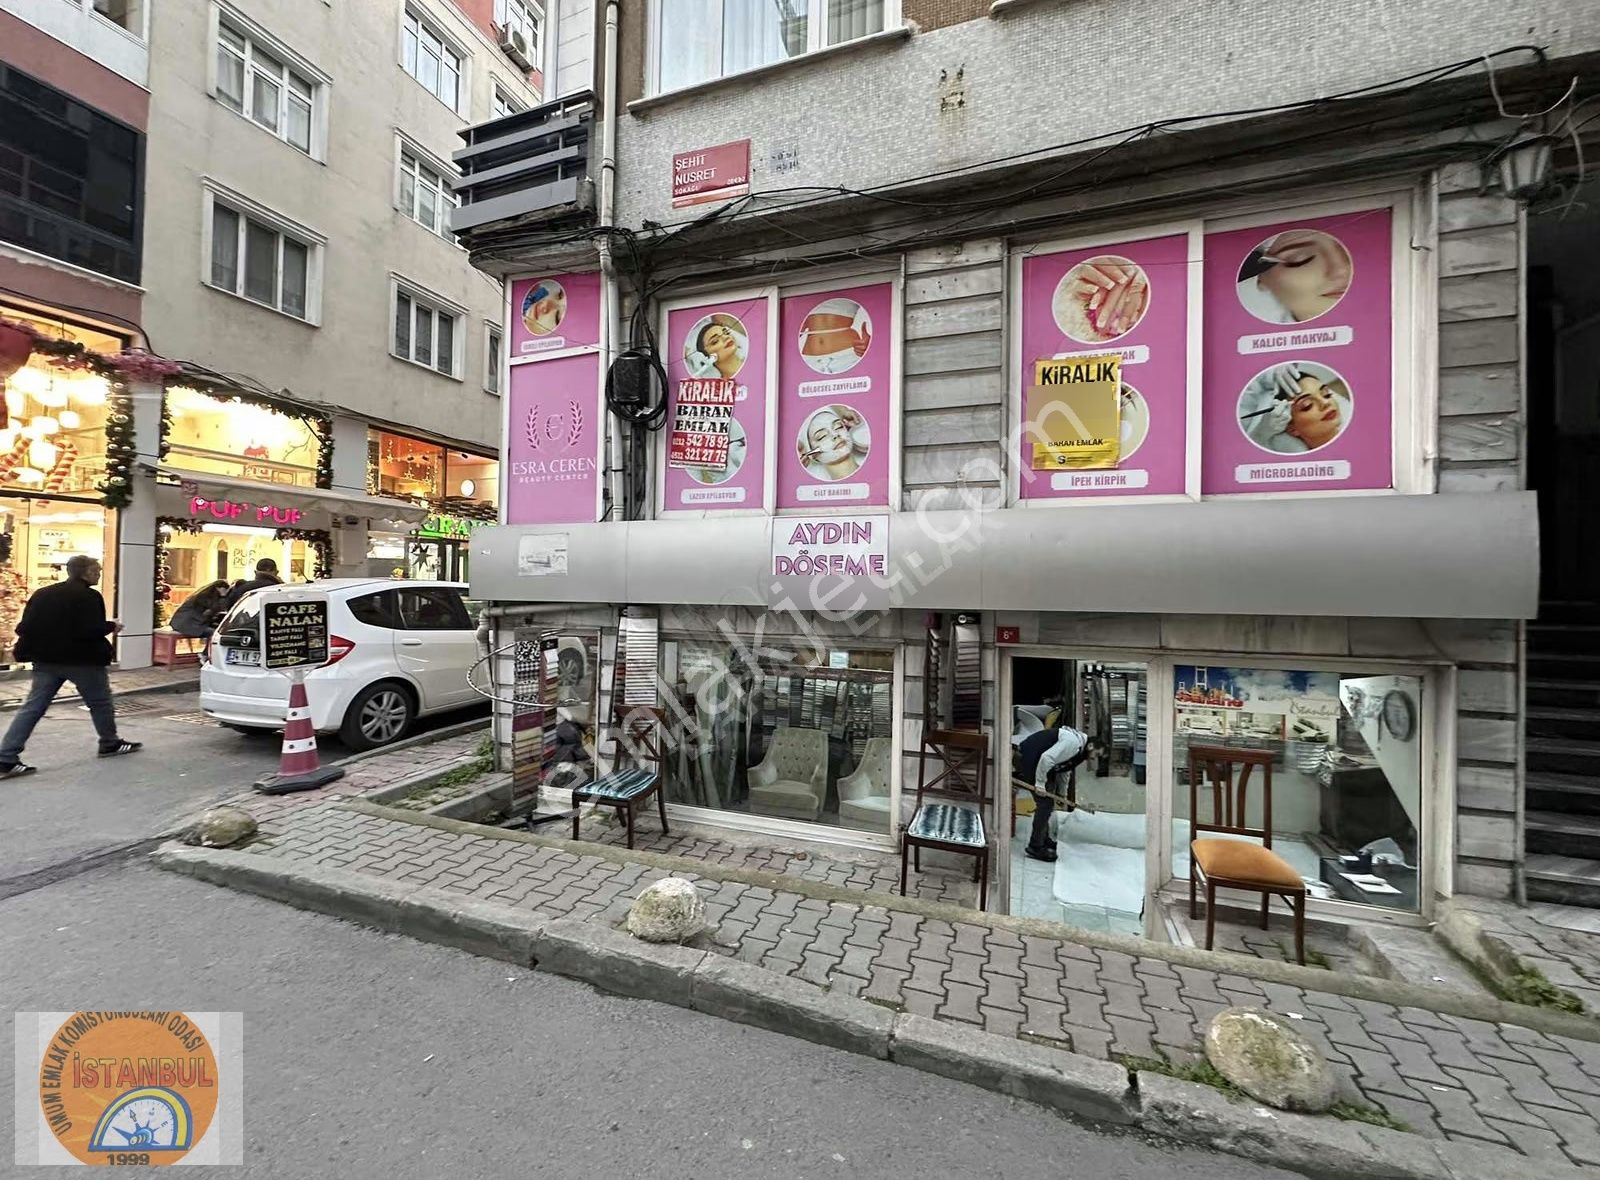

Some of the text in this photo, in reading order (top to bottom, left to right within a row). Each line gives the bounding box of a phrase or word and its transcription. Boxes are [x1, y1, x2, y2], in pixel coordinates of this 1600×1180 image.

[675, 153, 707, 172] ŞEHİT
[675, 168, 717, 186] NUSRET
[1290, 332, 1337, 346] MAKYAJ
[677, 405, 732, 418] BARAN
[675, 420, 729, 433] EMLAK
[685, 434, 703, 447] 542
[704, 435, 716, 448] 78
[717, 436, 729, 448] 92
[684, 448, 701, 460] 321
[702, 449, 714, 461] 27
[715, 450, 727, 462] 75
[512, 457, 596, 475] ESRA CEREN
[788, 522, 872, 545] AYDIN
[276, 604, 317, 615] CAFE
[269, 615, 324, 627] NALAN
